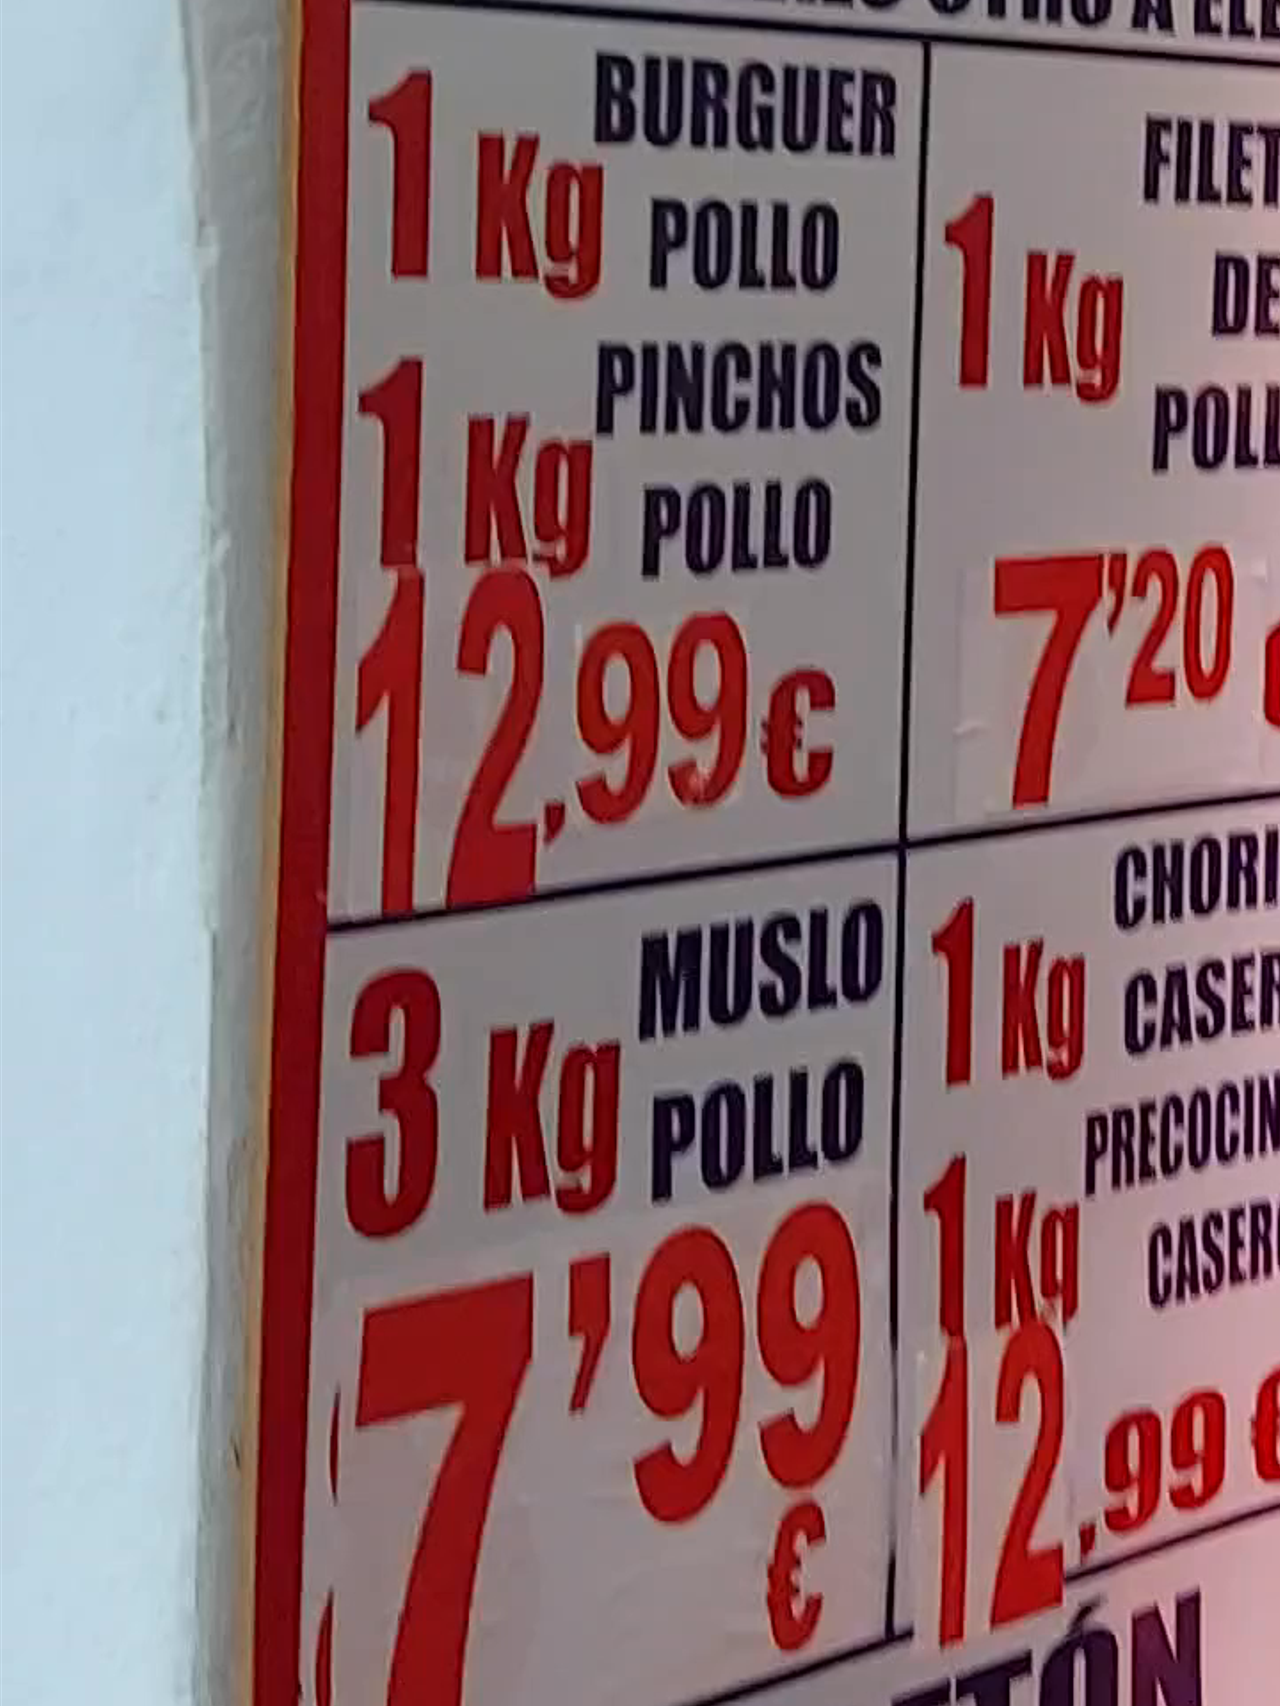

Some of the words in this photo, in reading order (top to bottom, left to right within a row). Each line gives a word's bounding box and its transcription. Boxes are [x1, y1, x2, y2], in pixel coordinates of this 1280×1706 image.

[367, 69, 432, 282] 1
[475, 132, 605, 300] Kg
[594, 50, 897, 158] BURGUER
[648, 197, 841, 293] POLLO
[944, 192, 995, 389] 1
[1021, 251, 1124, 404] Kg
[357, 357, 424, 571] 1
[463, 413, 594, 581] Kg
[595, 340, 883, 437] PINCHOS
[640, 477, 832, 580] POLLO
[636, 898, 886, 1043] MUSLO
[931, 896, 976, 1088] 1
[1000, 938, 1088, 1083] Kg
[344, 969, 439, 1241] 3
[482, 1019, 622, 1215] Kg
[650, 1058, 866, 1204] POLLO
[923, 1155, 970, 1342] 1
[994, 1193, 1081, 1334] Kg
